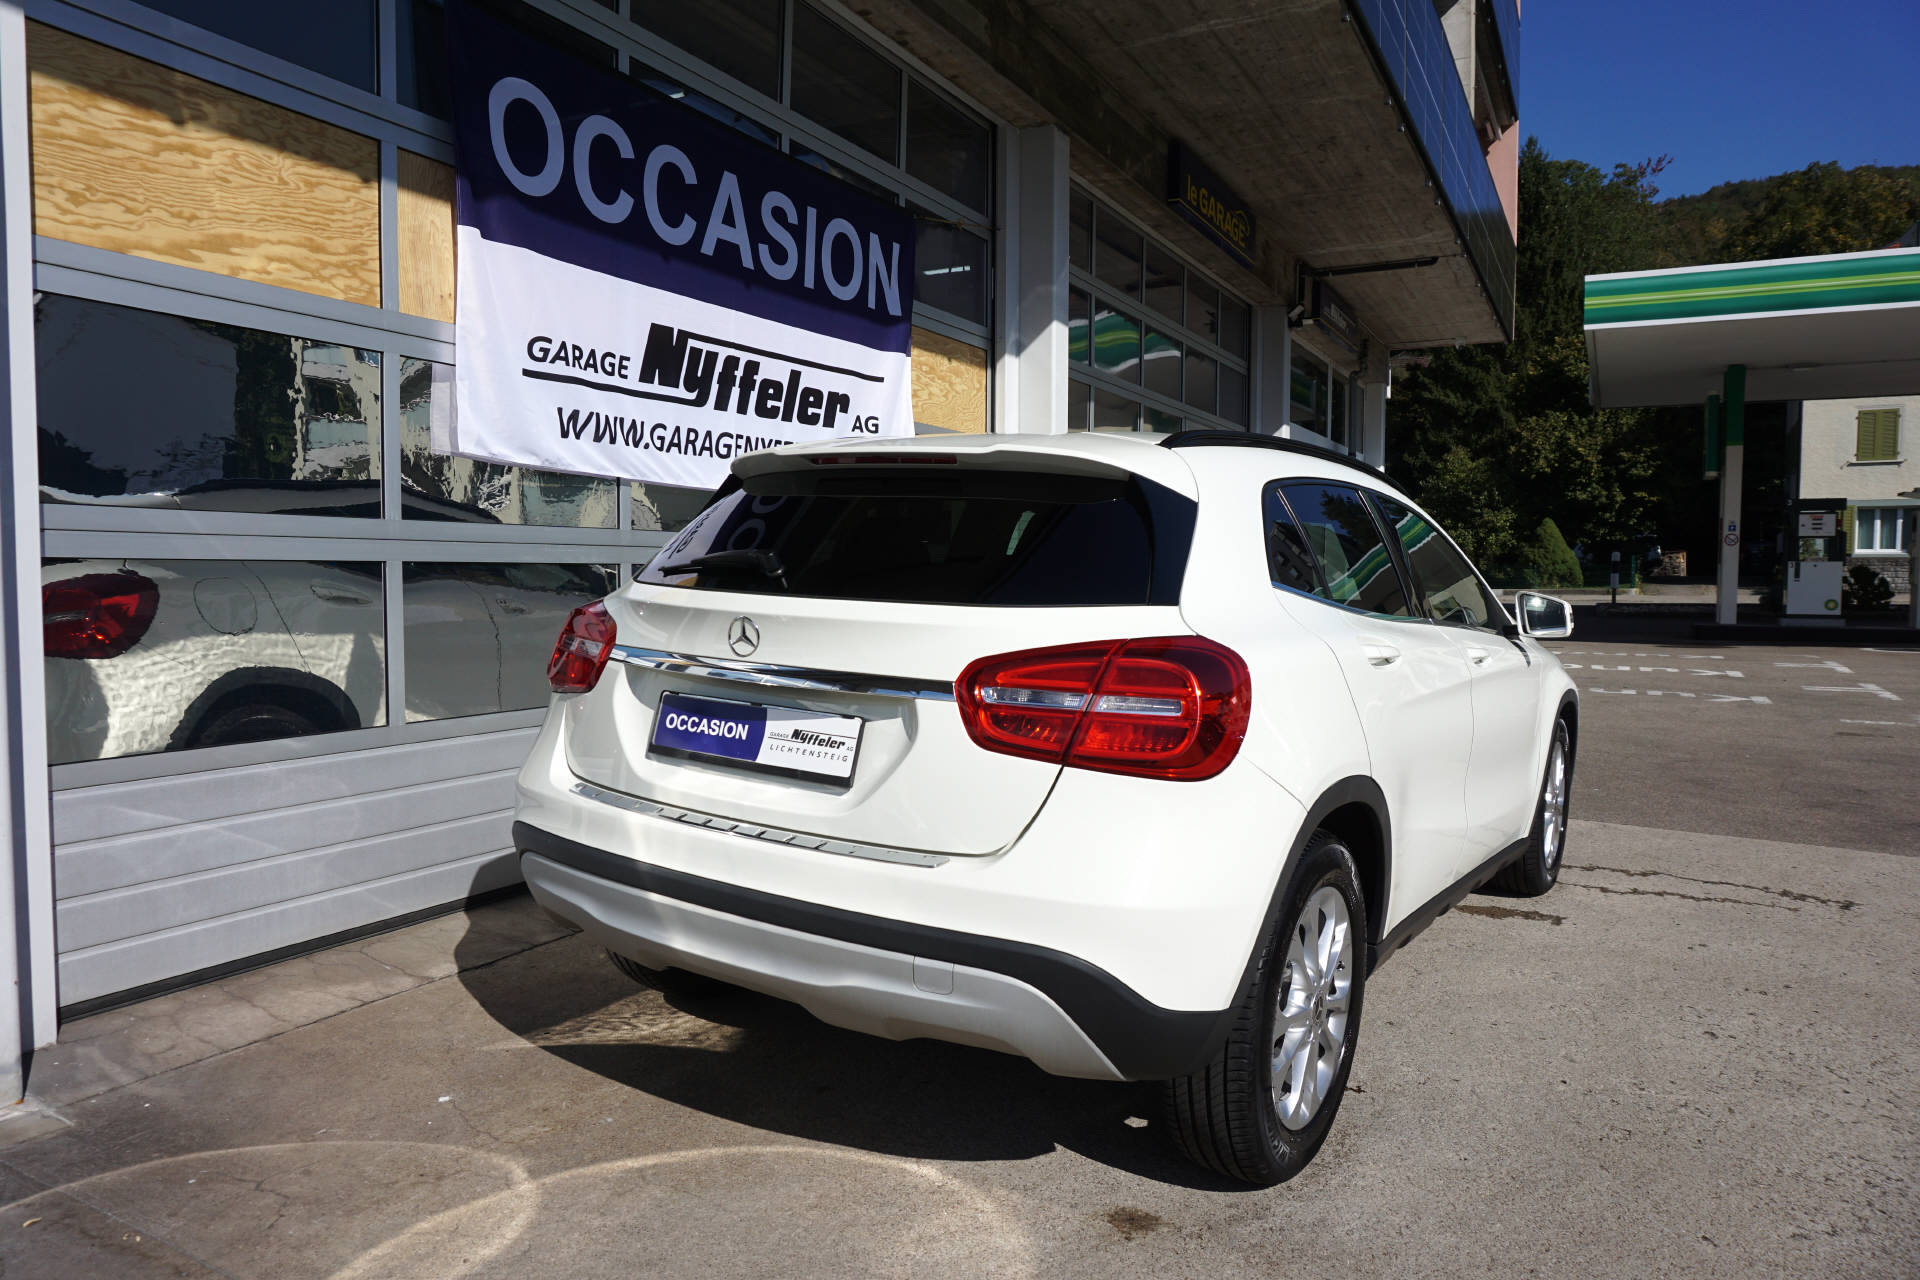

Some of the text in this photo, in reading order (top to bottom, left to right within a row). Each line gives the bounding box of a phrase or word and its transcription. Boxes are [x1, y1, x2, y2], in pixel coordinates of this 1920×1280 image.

[488, 77, 902, 316] OCCASION
[1187, 175, 1246, 247] le GARAGE
[526, 323, 879, 434] GARAGE Nyffeler AG
[557, 407, 794, 459] WWW.GARAGENY
[666, 713, 749, 740] OCCASION
[769, 731, 790, 739] GARAGE
[791, 728, 846, 749] Nyffeler
[769, 743, 848, 762] LICHTENSTEIG
